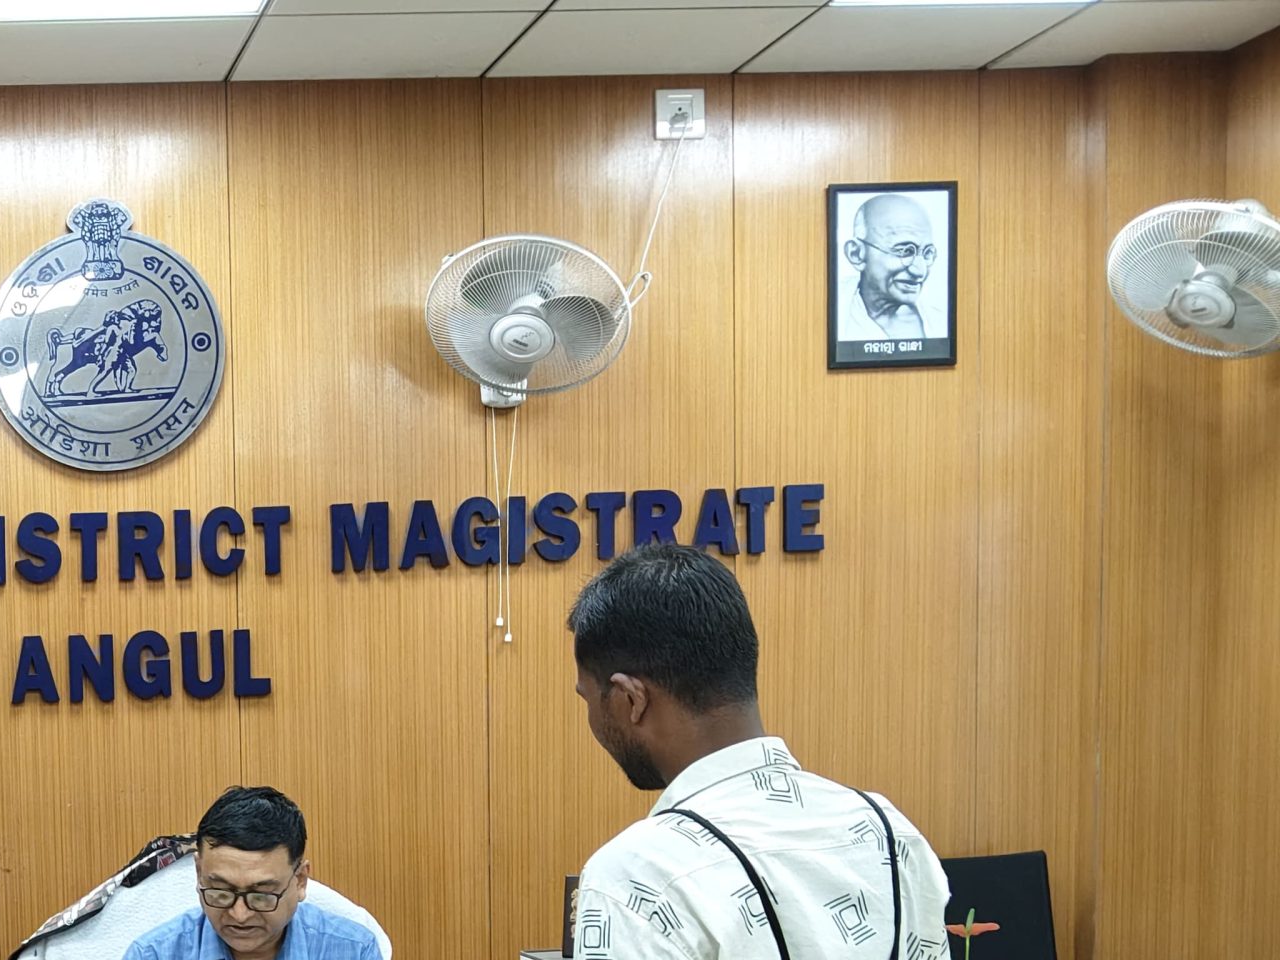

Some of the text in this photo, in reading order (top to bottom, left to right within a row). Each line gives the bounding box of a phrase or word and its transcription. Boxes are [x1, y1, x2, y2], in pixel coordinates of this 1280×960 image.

[130, 397, 196, 451] शासन
[330, 484, 825, 573] MAGISTRATE
[11, 629, 272, 705] ANGUL
